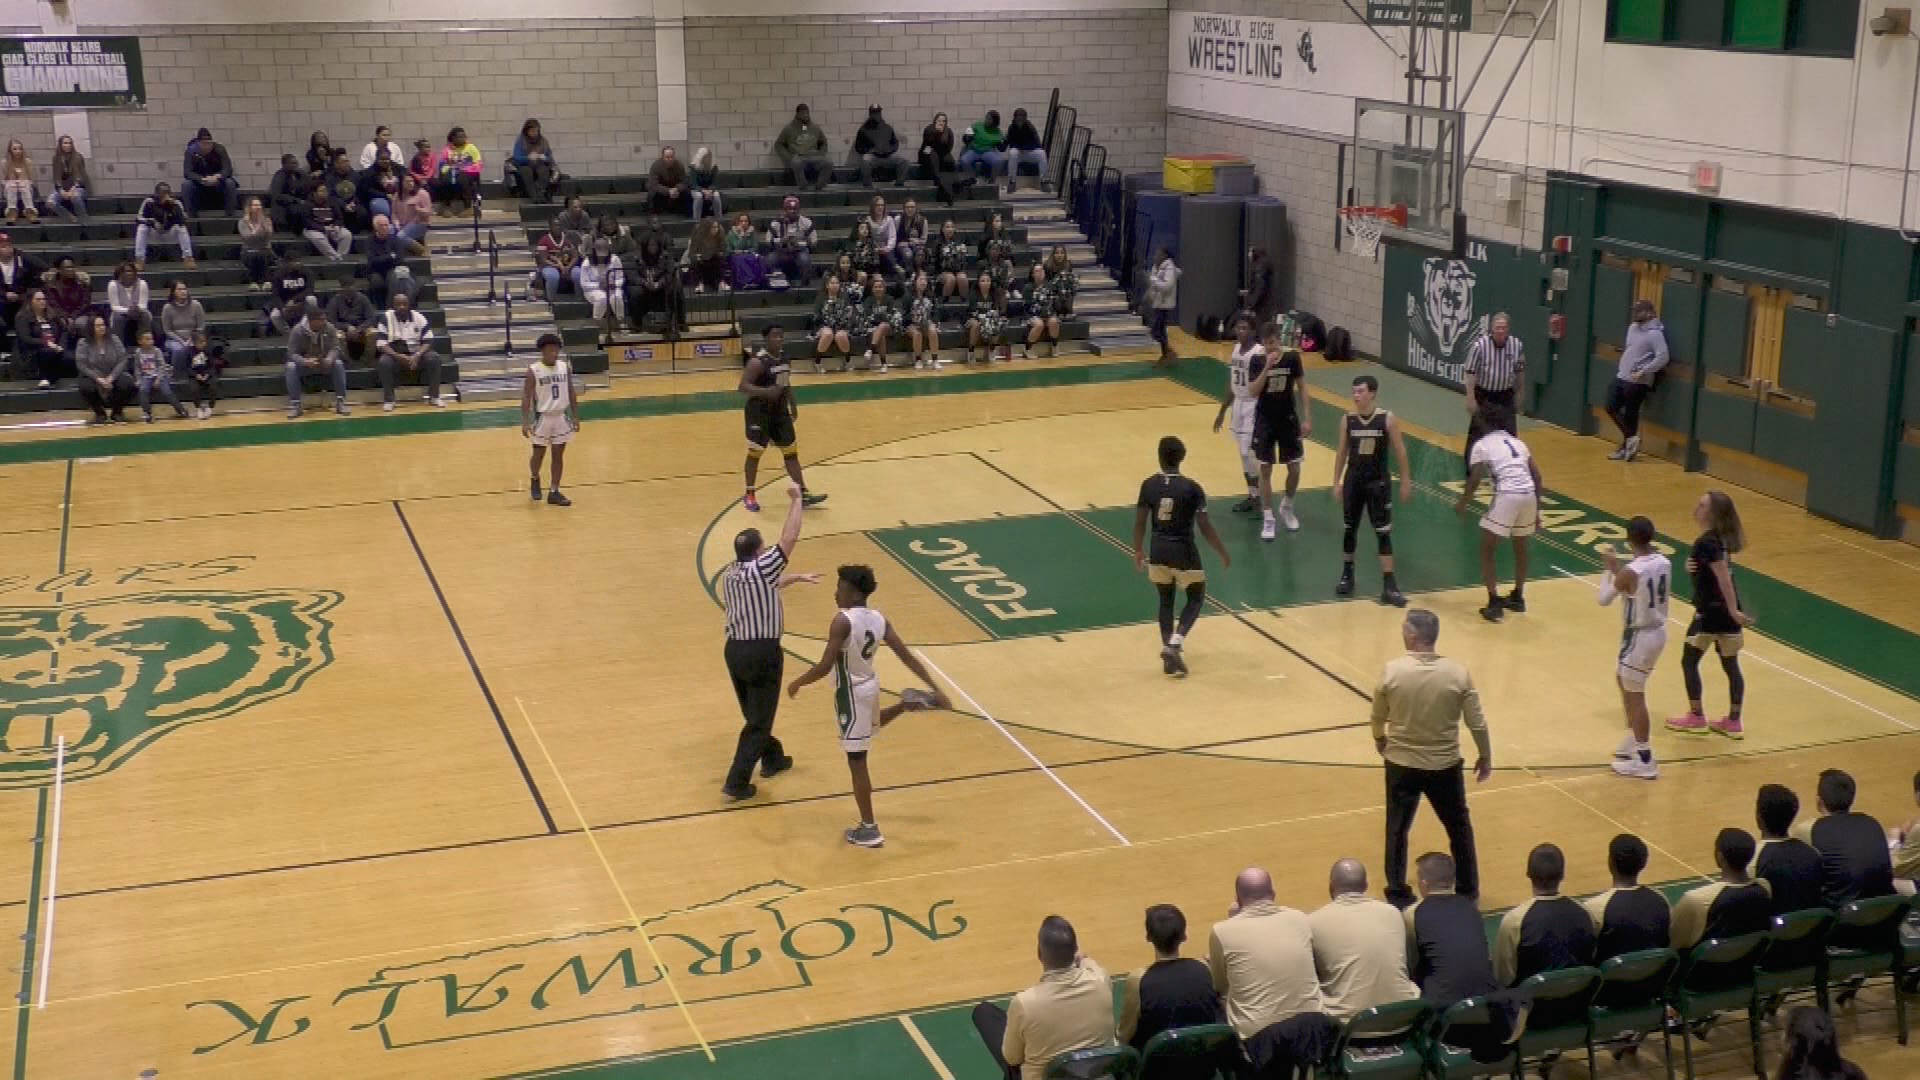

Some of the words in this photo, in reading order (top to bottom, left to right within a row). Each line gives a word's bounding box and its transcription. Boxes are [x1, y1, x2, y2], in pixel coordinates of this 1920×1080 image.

[1193, 16, 1241, 36] NORWALK
[1249, 21, 1275, 40] HIGH
[1, 53, 25, 65] CIAC
[26, 53, 58, 65] CLASS
[71, 52, 127, 65] BASKETBALL
[24, 41, 69, 53] NORWALK
[70, 41, 102, 53] BEARS
[1188, 36, 1283, 79] WRESTLING
[3, 65, 129, 93] CHAMPIONS
[283, 277, 305, 289] POLO
[1408, 332, 1435, 374] HIGH
[1436, 359, 1466, 385] SCHO
[1233, 369, 1247, 387] 31
[1504, 439, 1520, 459] 1
[1157, 497, 1175, 521] 2
[909, 537, 1058, 620] FCIAC
[1647, 573, 1667, 609] 14
[861, 629, 875, 660] 2
[186, 898, 968, 1056] NORWALK
